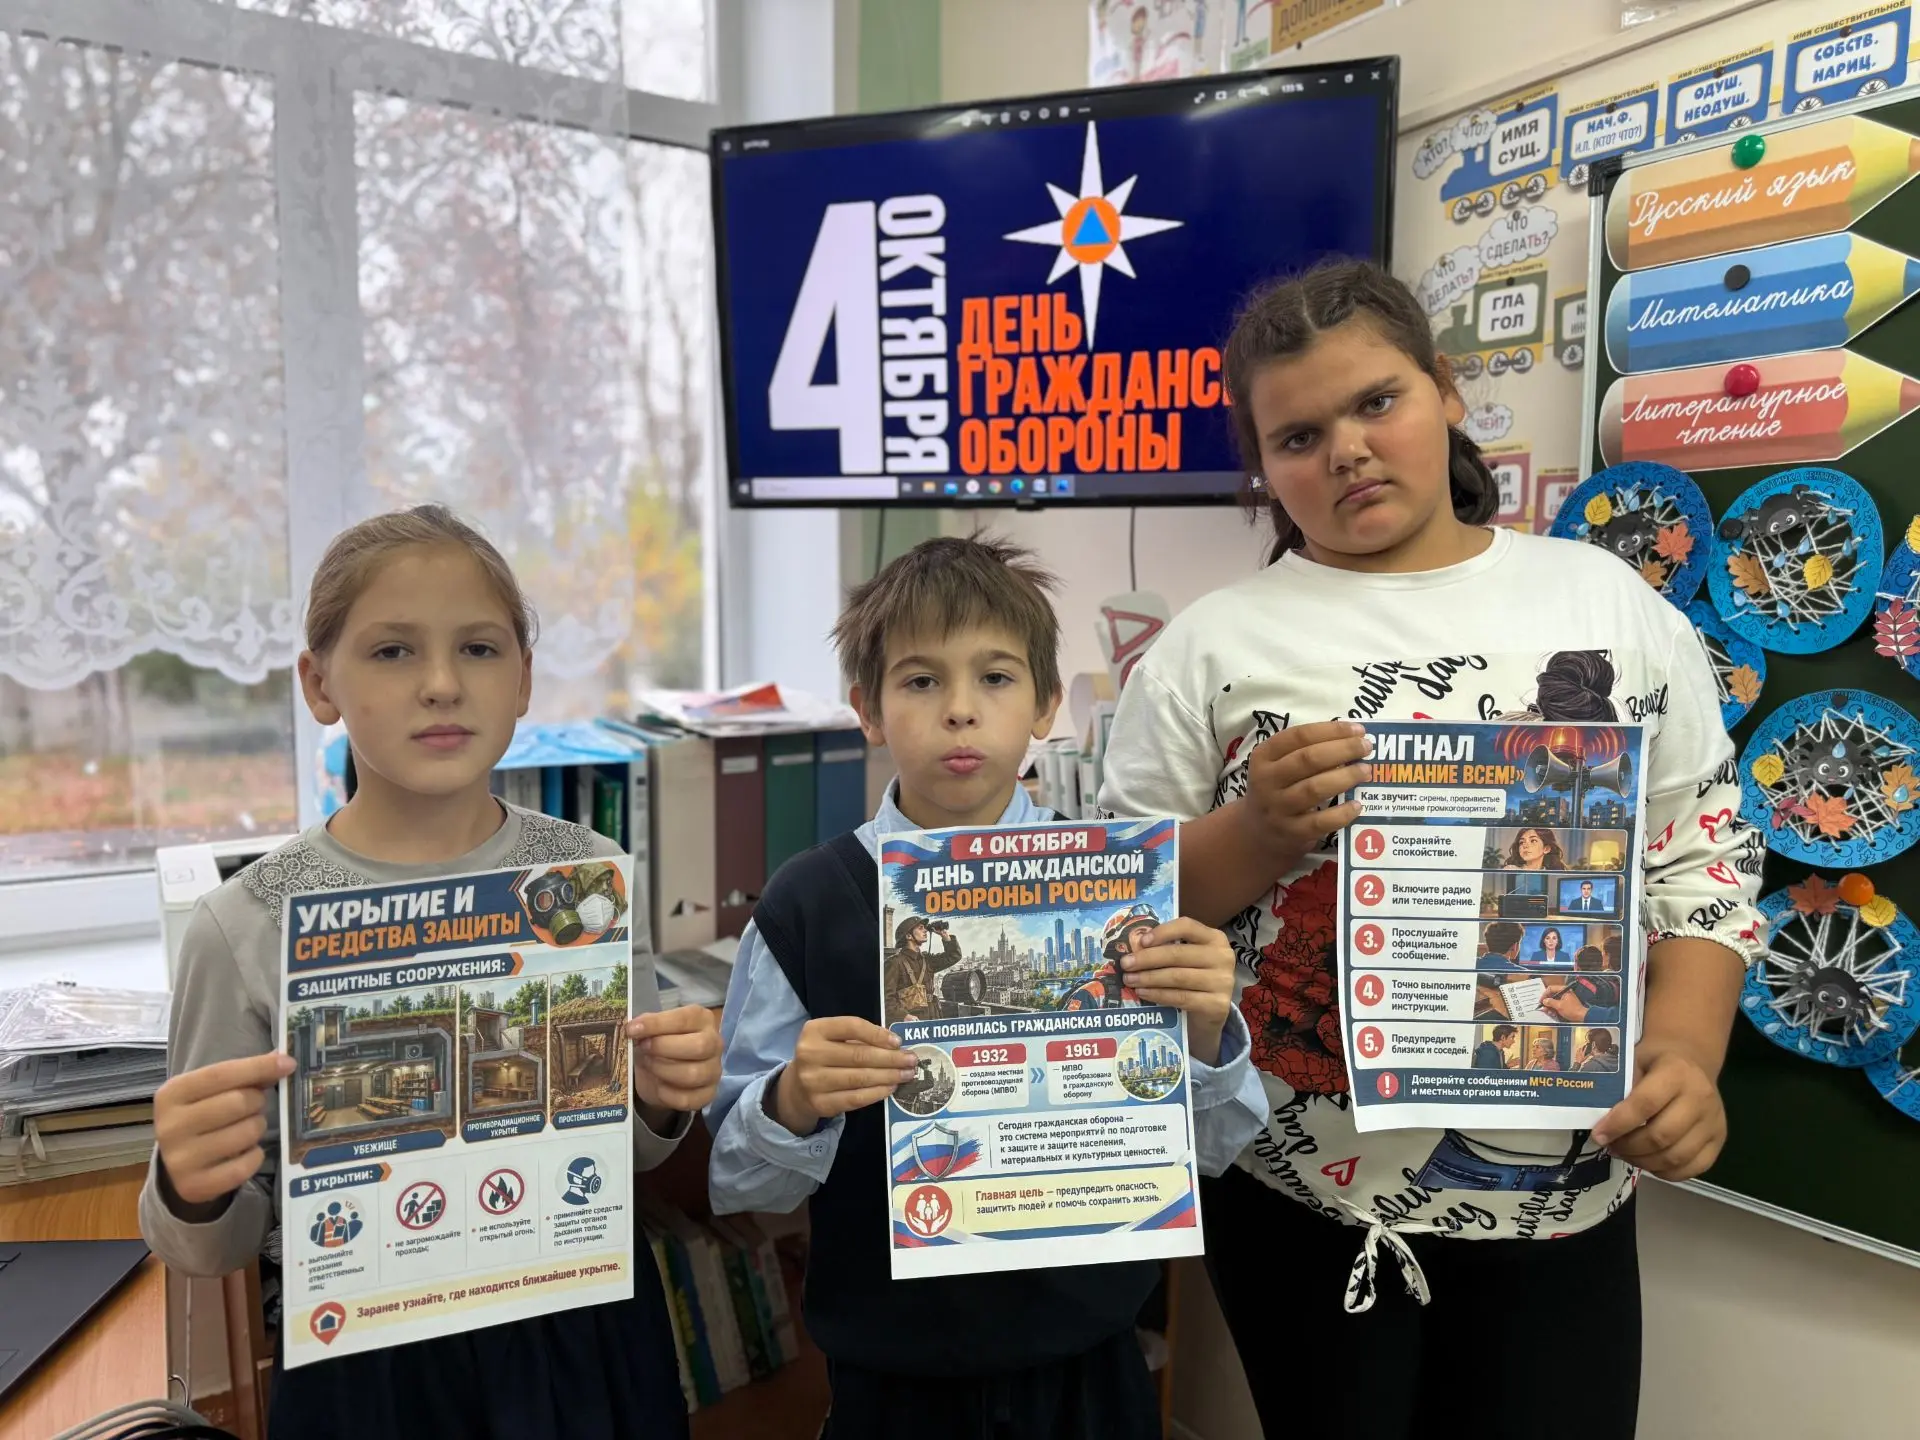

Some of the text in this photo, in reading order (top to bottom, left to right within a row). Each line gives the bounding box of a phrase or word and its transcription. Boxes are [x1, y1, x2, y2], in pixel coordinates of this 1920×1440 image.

[1814, 33, 1878, 61] СОБСТВ.
[1813, 54, 1876, 83] НАРИЦ.
[1694, 75, 1742, 100] ОДУШ.
[1684, 92, 1750, 122] НЕОДУШ.
[1502, 119, 1538, 144] ИМЯ
[1498, 142, 1540, 165] СУЩ.
[1628, 159, 1856, 236] Русский язык
[1506, 216, 1528, 233] ЧТО
[1486, 230, 1548, 261] СДЕЛАТЬ?
[1492, 293, 1525, 310] ГЛА
[1626, 279, 1852, 332] Математика
[961, 293, 1082, 362] ДЕНЬ
[1490, 314, 1524, 332] ГОЛ
[768, 201, 884, 474] 4
[878, 195, 950, 473] ОКТЯБРЯ
[959, 346, 1233, 420] ГРАЖДАНС
[1621, 382, 1847, 427] Литературное
[1676, 419, 1782, 444] чтение
[960, 412, 1181, 473] ОБОРОНЫ
[1372, 763, 1458, 784] НИМАНИЕ
[1361, 792, 1380, 800] Как
[1382, 793, 1417, 802] звучит:
[1392, 804, 1424, 812] уличные
[1427, 805, 1498, 813] громкоговорители.
[969, 831, 1088, 856] 4 ОКТЯБРЯ
[1364, 835, 1451, 853] 1. Сохраняйте
[1392, 848, 1457, 857] спокойствие.
[914, 850, 1144, 892] ДЕНЬ ГРАЖДАНСКОЙ
[925, 878, 1136, 914] ОБОРОНЫ РОССИИ
[1363, 881, 1471, 898] 2. Включите радио
[296, 886, 475, 934] УКРЫТИЕ И
[1412, 898, 1476, 906] телевидение.
[294, 911, 522, 962] СРЕДСТВА ЗАЩИТЫ
[1363, 928, 1458, 948] 3. Прослушайте
[1392, 940, 1458, 949] официальное
[1392, 951, 1449, 960] сообщение.
[298, 958, 506, 998] ЗАЩИТНЫЕ СООРУЖЕНИЯ:
[1362, 980, 1471, 999] 4. Точно выполните
[1392, 992, 1448, 1001] полученные
[1392, 1003, 1448, 1012] инструкции.
[904, 1012, 1164, 1041] КАК ПОЯВИЛАСЬ ГРАЖДАНСКАЯ ОБОРОНА
[1065, 1043, 1100, 1058] 1961
[1364, 1033, 1456, 1052] 5. Предупредите
[1392, 1045, 1424, 1054] близких
[1434, 1046, 1468, 1055] соседей.
[972, 1048, 1008, 1064] 1932
[970, 1070, 996, 1078] создана
[1062, 1064, 1083, 1072] МПВО
[961, 1078, 1024, 1088] противовоздушная
[1062, 1072, 1112, 1082] преобразована
[1068, 1080, 1114, 1090] гражданскую
[1412, 1074, 1594, 1089] Доверяйте сообщениям МЧС России
[962, 1086, 1018, 1096] оборона (МПВО)
[1063, 1090, 1092, 1099] оборону
[1420, 1088, 1460, 1096] местных
[1463, 1088, 1501, 1098] органов
[1503, 1089, 1540, 1098] власти.
[467, 1114, 541, 1132] ПРОТИВОРАДИАЦИОННОЕ
[558, 1108, 624, 1124] ПРОСТЕЙШЕЕ УКРЫТИЕ
[998, 1115, 1124, 1131] Сегодня гражданская оборона
[490, 1126, 518, 1138] УКРЫТИЕ
[1000, 1134, 1012, 1142] это
[1015, 1132, 1048, 1141] система
[1050, 1127, 1105, 1139] мероприятий
[1120, 1124, 1166, 1134] подготовке
[353, 1138, 398, 1156] УБЕЖИЩЕ
[1008, 1144, 1038, 1154] защите
[1047, 1141, 1078, 1150] защите
[1080, 1138, 1126, 1148] населения,
[1001, 1154, 1062, 1166] материальных
[1072, 1149, 1122, 1161] культурных
[1124, 1146, 1168, 1158] ценностей.
[300, 1168, 374, 1192] В укрытии:
[976, 1182, 1159, 1202] Главная цель предупредить опасность,
[554, 1204, 623, 1220] применяйте средства
[976, 1194, 1162, 1214] защитить людей помочь сохранить жизнь.
[489, 1218, 531, 1231] используйте
[554, 1215, 608, 1229] защиты органов
[406, 1230, 461, 1246] загромождайте
[480, 1227, 536, 1242] открытый огонь;
[554, 1224, 607, 1238] дыхания только
[554, 1234, 604, 1248] по инструкции.
[308, 1249, 353, 1264] выполняйте
[396, 1244, 430, 1257] проходы;
[308, 1260, 342, 1274] указания
[308, 1266, 364, 1283] ответственных
[356, 1262, 621, 1318] Заранее узнайте, где находится ближайшее укрытие.
